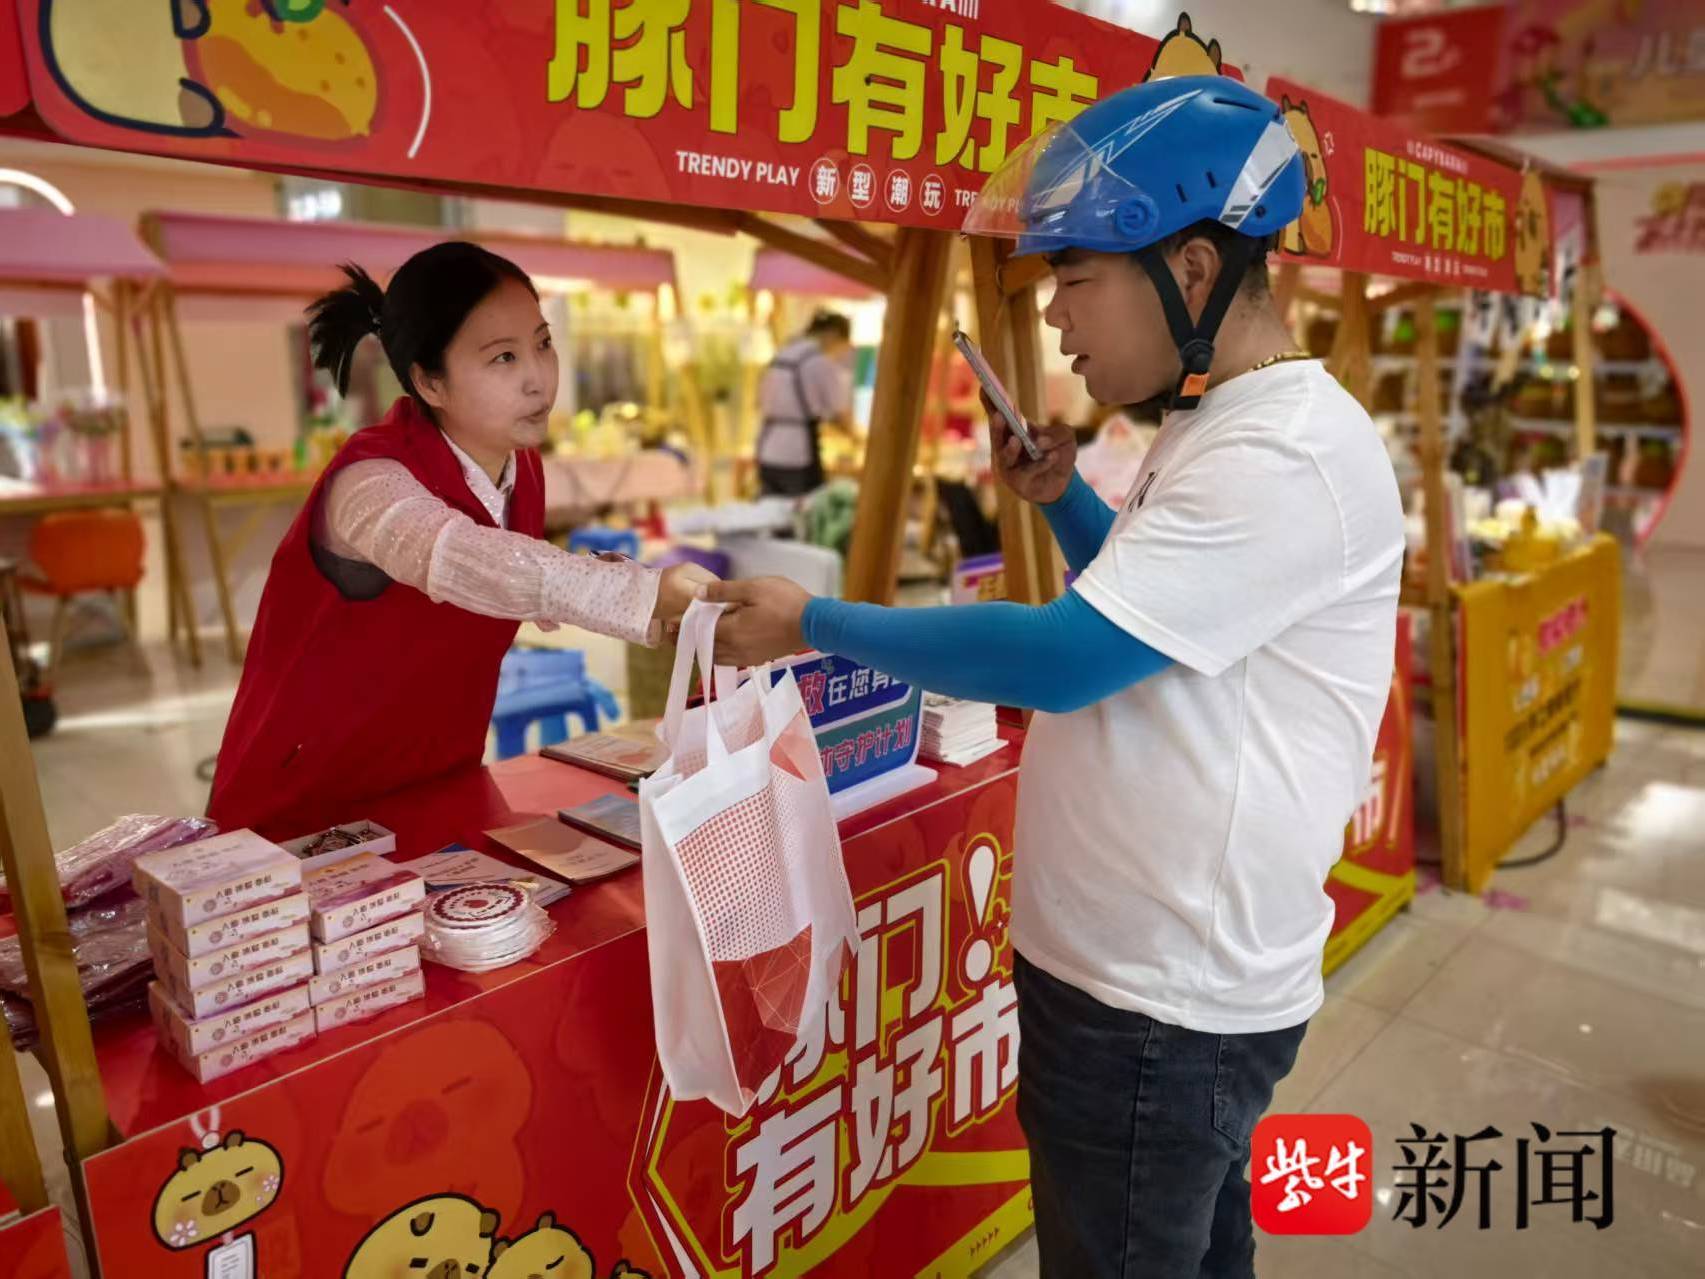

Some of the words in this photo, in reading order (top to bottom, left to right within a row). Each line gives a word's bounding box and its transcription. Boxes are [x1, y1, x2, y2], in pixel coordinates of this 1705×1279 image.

[676, 150, 752, 181] TRENDY
[756, 161, 800, 187] PLAY
[1364, 147, 1506, 262] 豚门有好市
